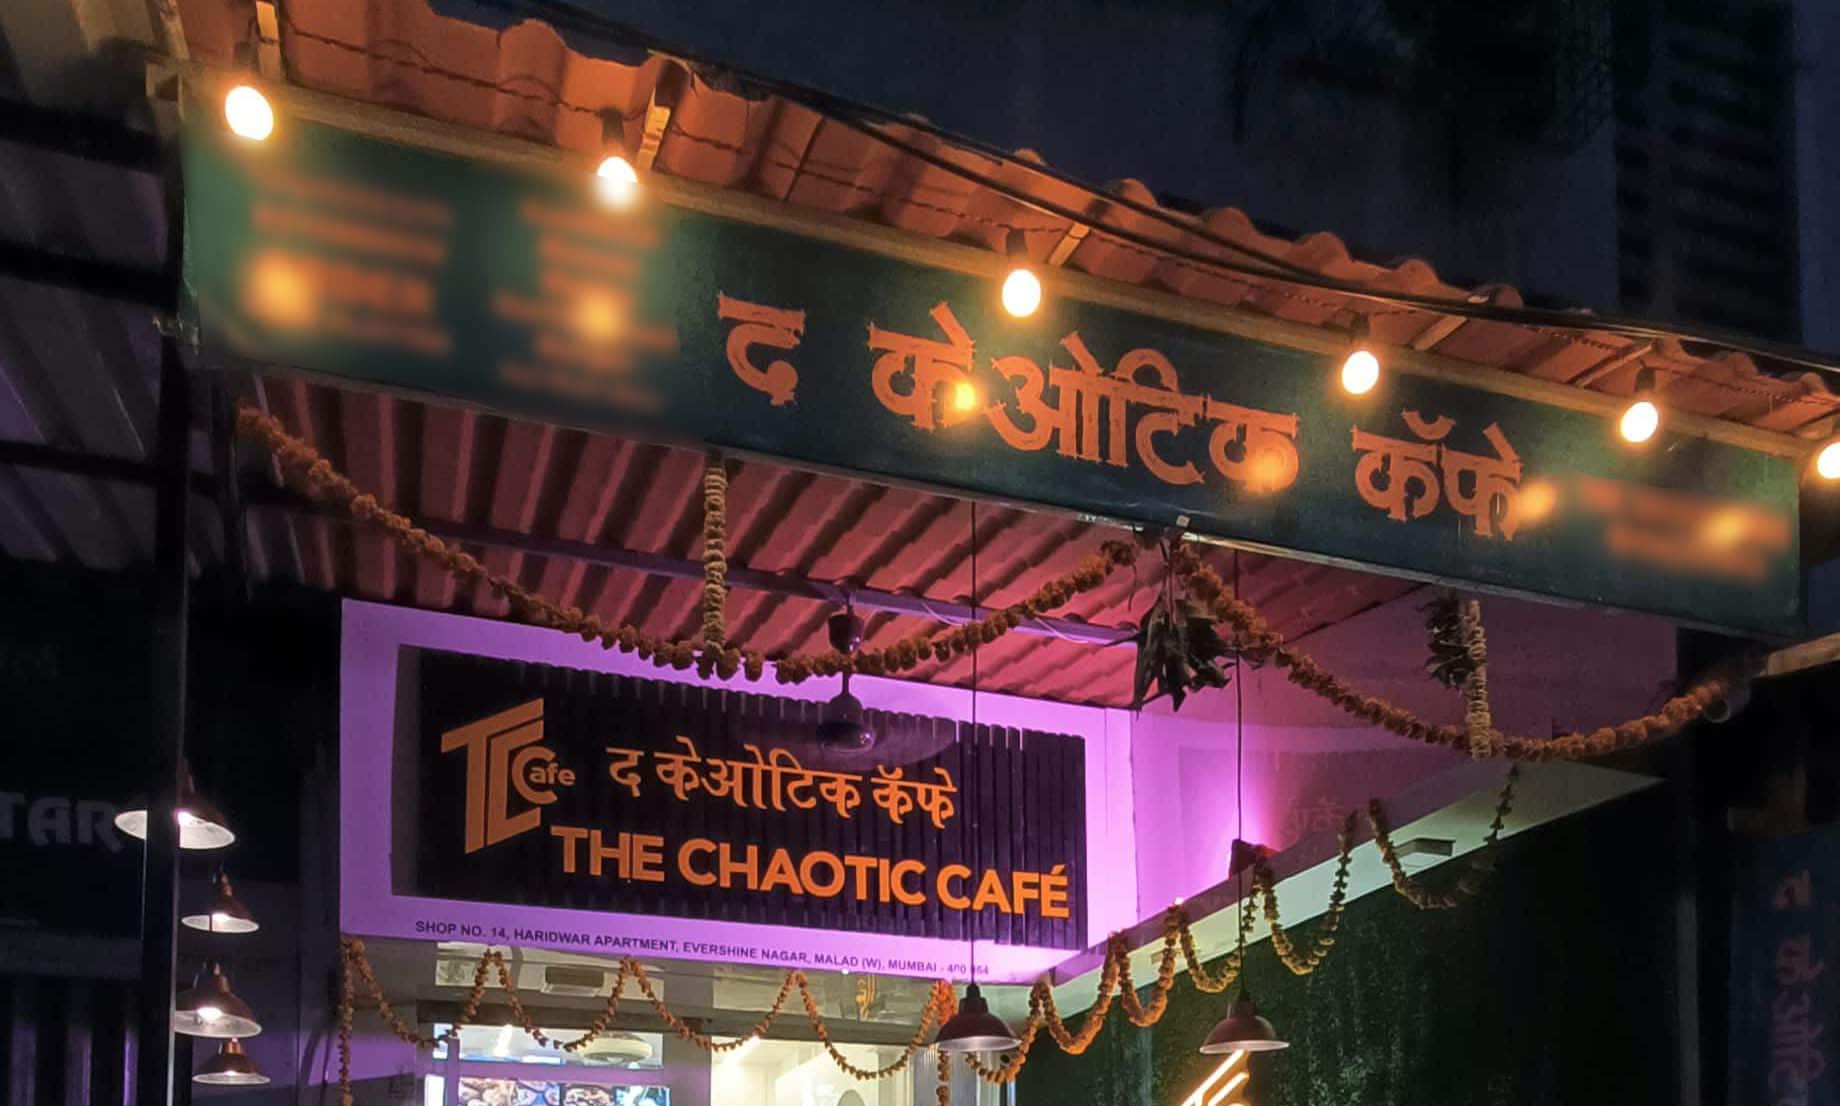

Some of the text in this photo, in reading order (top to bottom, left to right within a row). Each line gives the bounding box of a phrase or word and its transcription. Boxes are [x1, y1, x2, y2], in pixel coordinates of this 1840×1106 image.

[718, 289, 806, 406] द
[606, 735, 957, 829] द केओटिक कॅफे
[551, 826, 1070, 918] THE CHAOTIC CAFÉ
[415, 920, 457, 935] SHOP
[460, 924, 486, 938] NO.
[491, 926, 510, 941] 14,
[513, 927, 591, 946] HARIDWAR
[594, 934, 680, 953] APARTMENT,
[683, 941, 758, 959] EVERSHINE
[761, 948, 812, 965] NAGAR,
[814, 953, 859, 968] MALAD
[861, 956, 885, 971] (W),
[888, 960, 937, 973] MUMBAI
